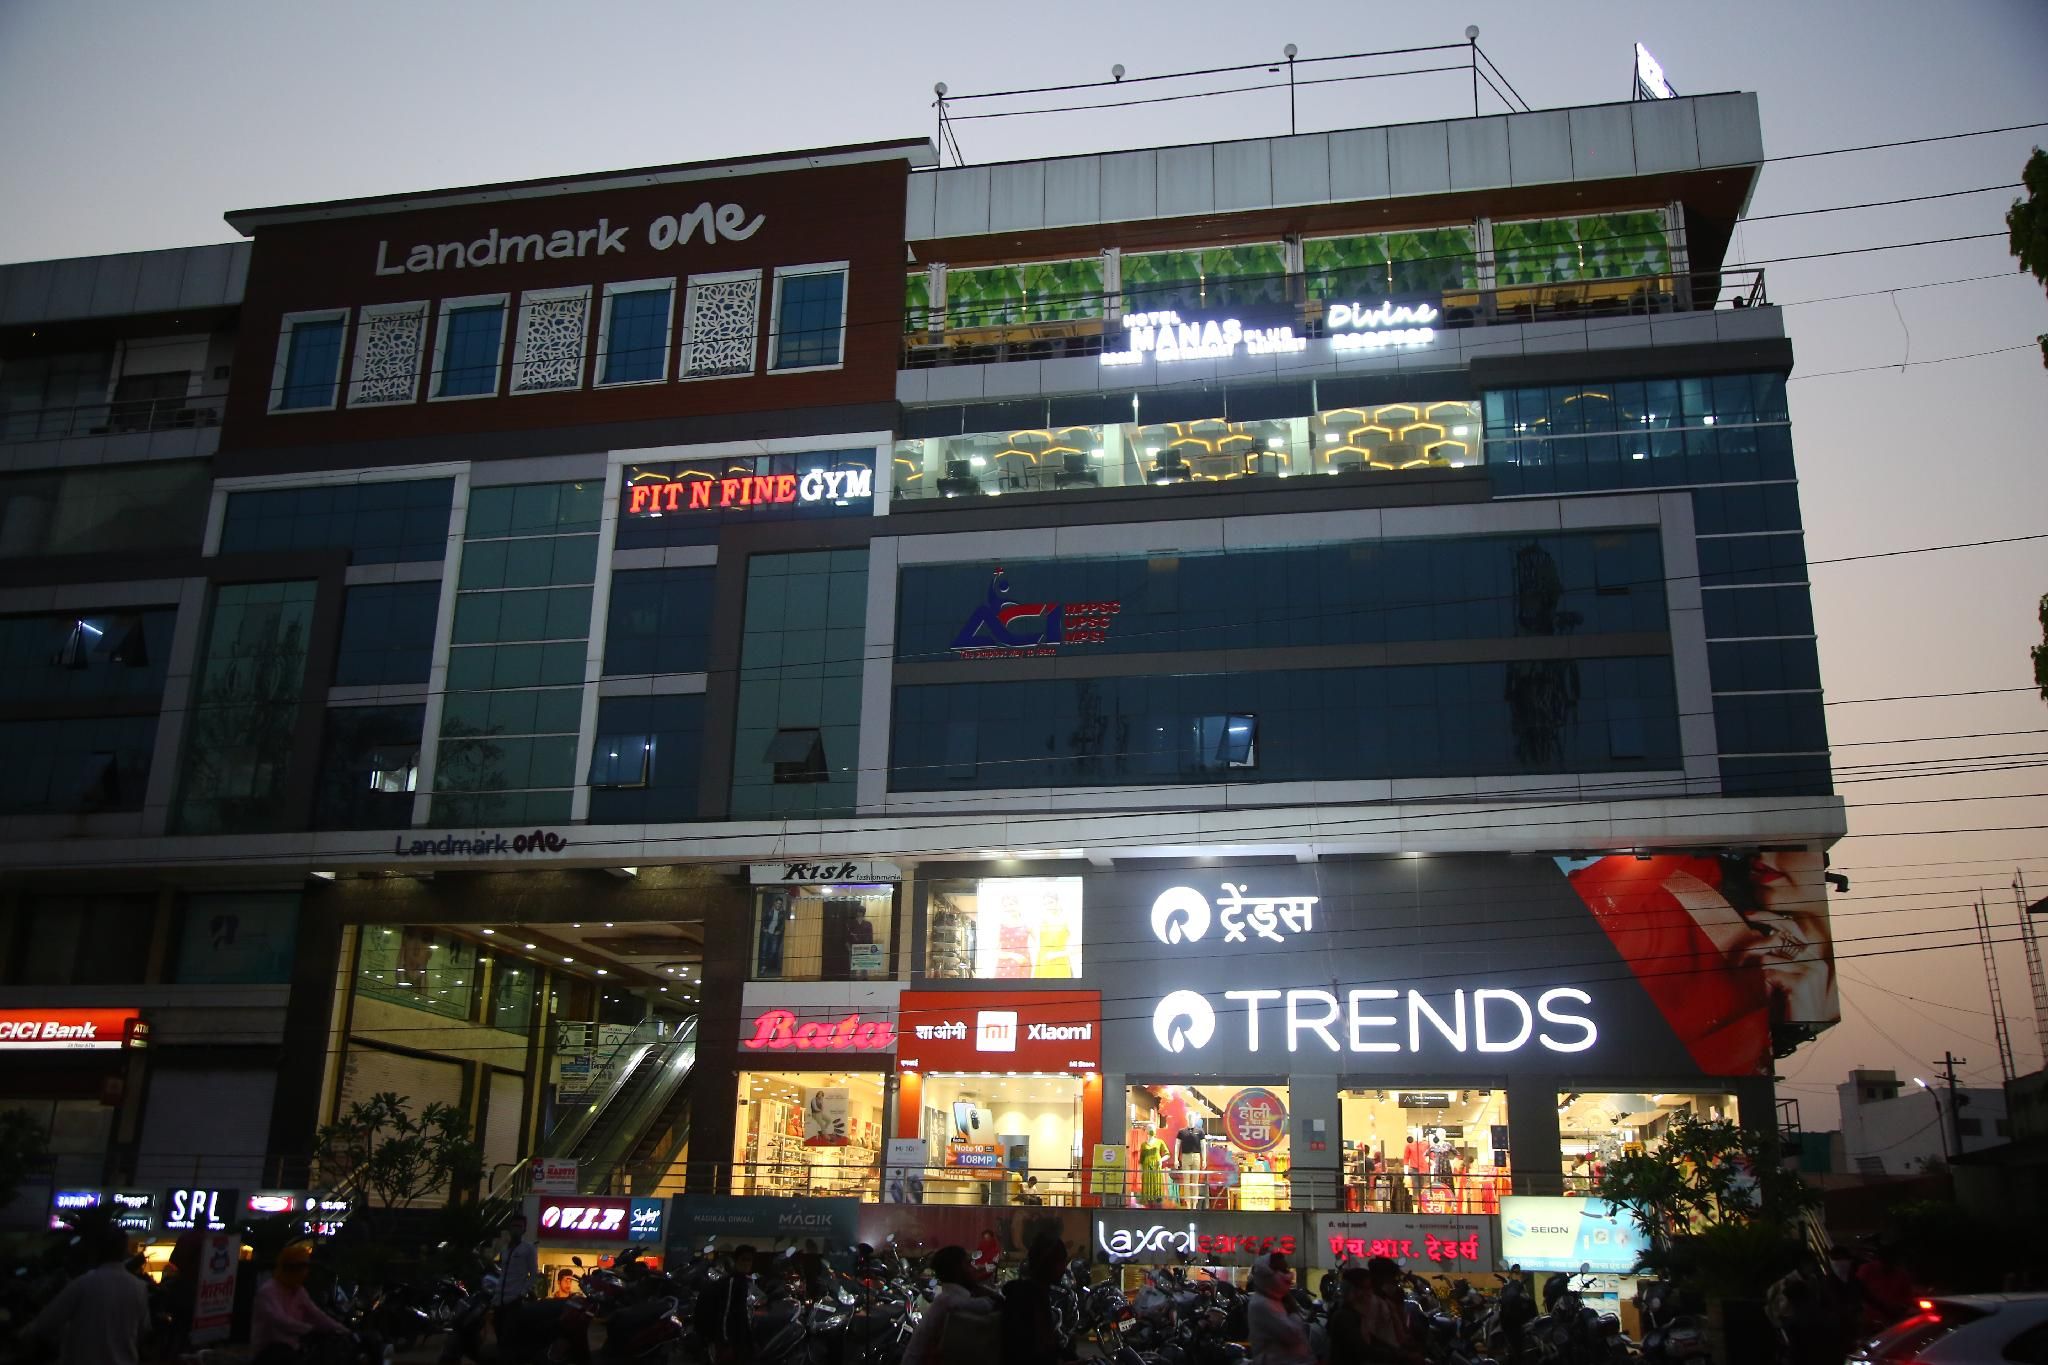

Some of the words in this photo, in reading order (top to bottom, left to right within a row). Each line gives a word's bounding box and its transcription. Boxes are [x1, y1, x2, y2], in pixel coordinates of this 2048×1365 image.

[376, 219, 629, 276] Landmark
[649, 202, 766, 250] one
[1123, 311, 1181, 328] HOTEL
[1328, 300, 1438, 328] Divine
[1130, 319, 1243, 351] MANAS
[630, 483, 682, 512] FIT
[689, 481, 712, 509] N
[720, 475, 796, 507] FINE
[800, 469, 872, 500] GYM
[1064, 616, 1111, 629] UPSC
[395, 833, 507, 856] Landmark
[513, 830, 567, 854] one
[1217, 883, 1319, 943] ट्रेंड्स
[745, 1009, 897, 1050] Bata
[1225, 987, 1599, 1053] TRENDS
[42, 1021, 97, 1039] Bank
[915, 1021, 967, 1040] शाओमी
[1028, 1023, 1092, 1040] Xiaomi
[1239, 1102, 1270, 1119] होली
[1239, 1121, 1270, 1140] रंग
[954, 1144, 974, 1152] Note
[975, 1145, 983, 1153] 10
[961, 1155, 993, 1165] 108MP
[778, 1213, 833, 1225] MAGIK
[1531, 1226, 1569, 1234] SEION
